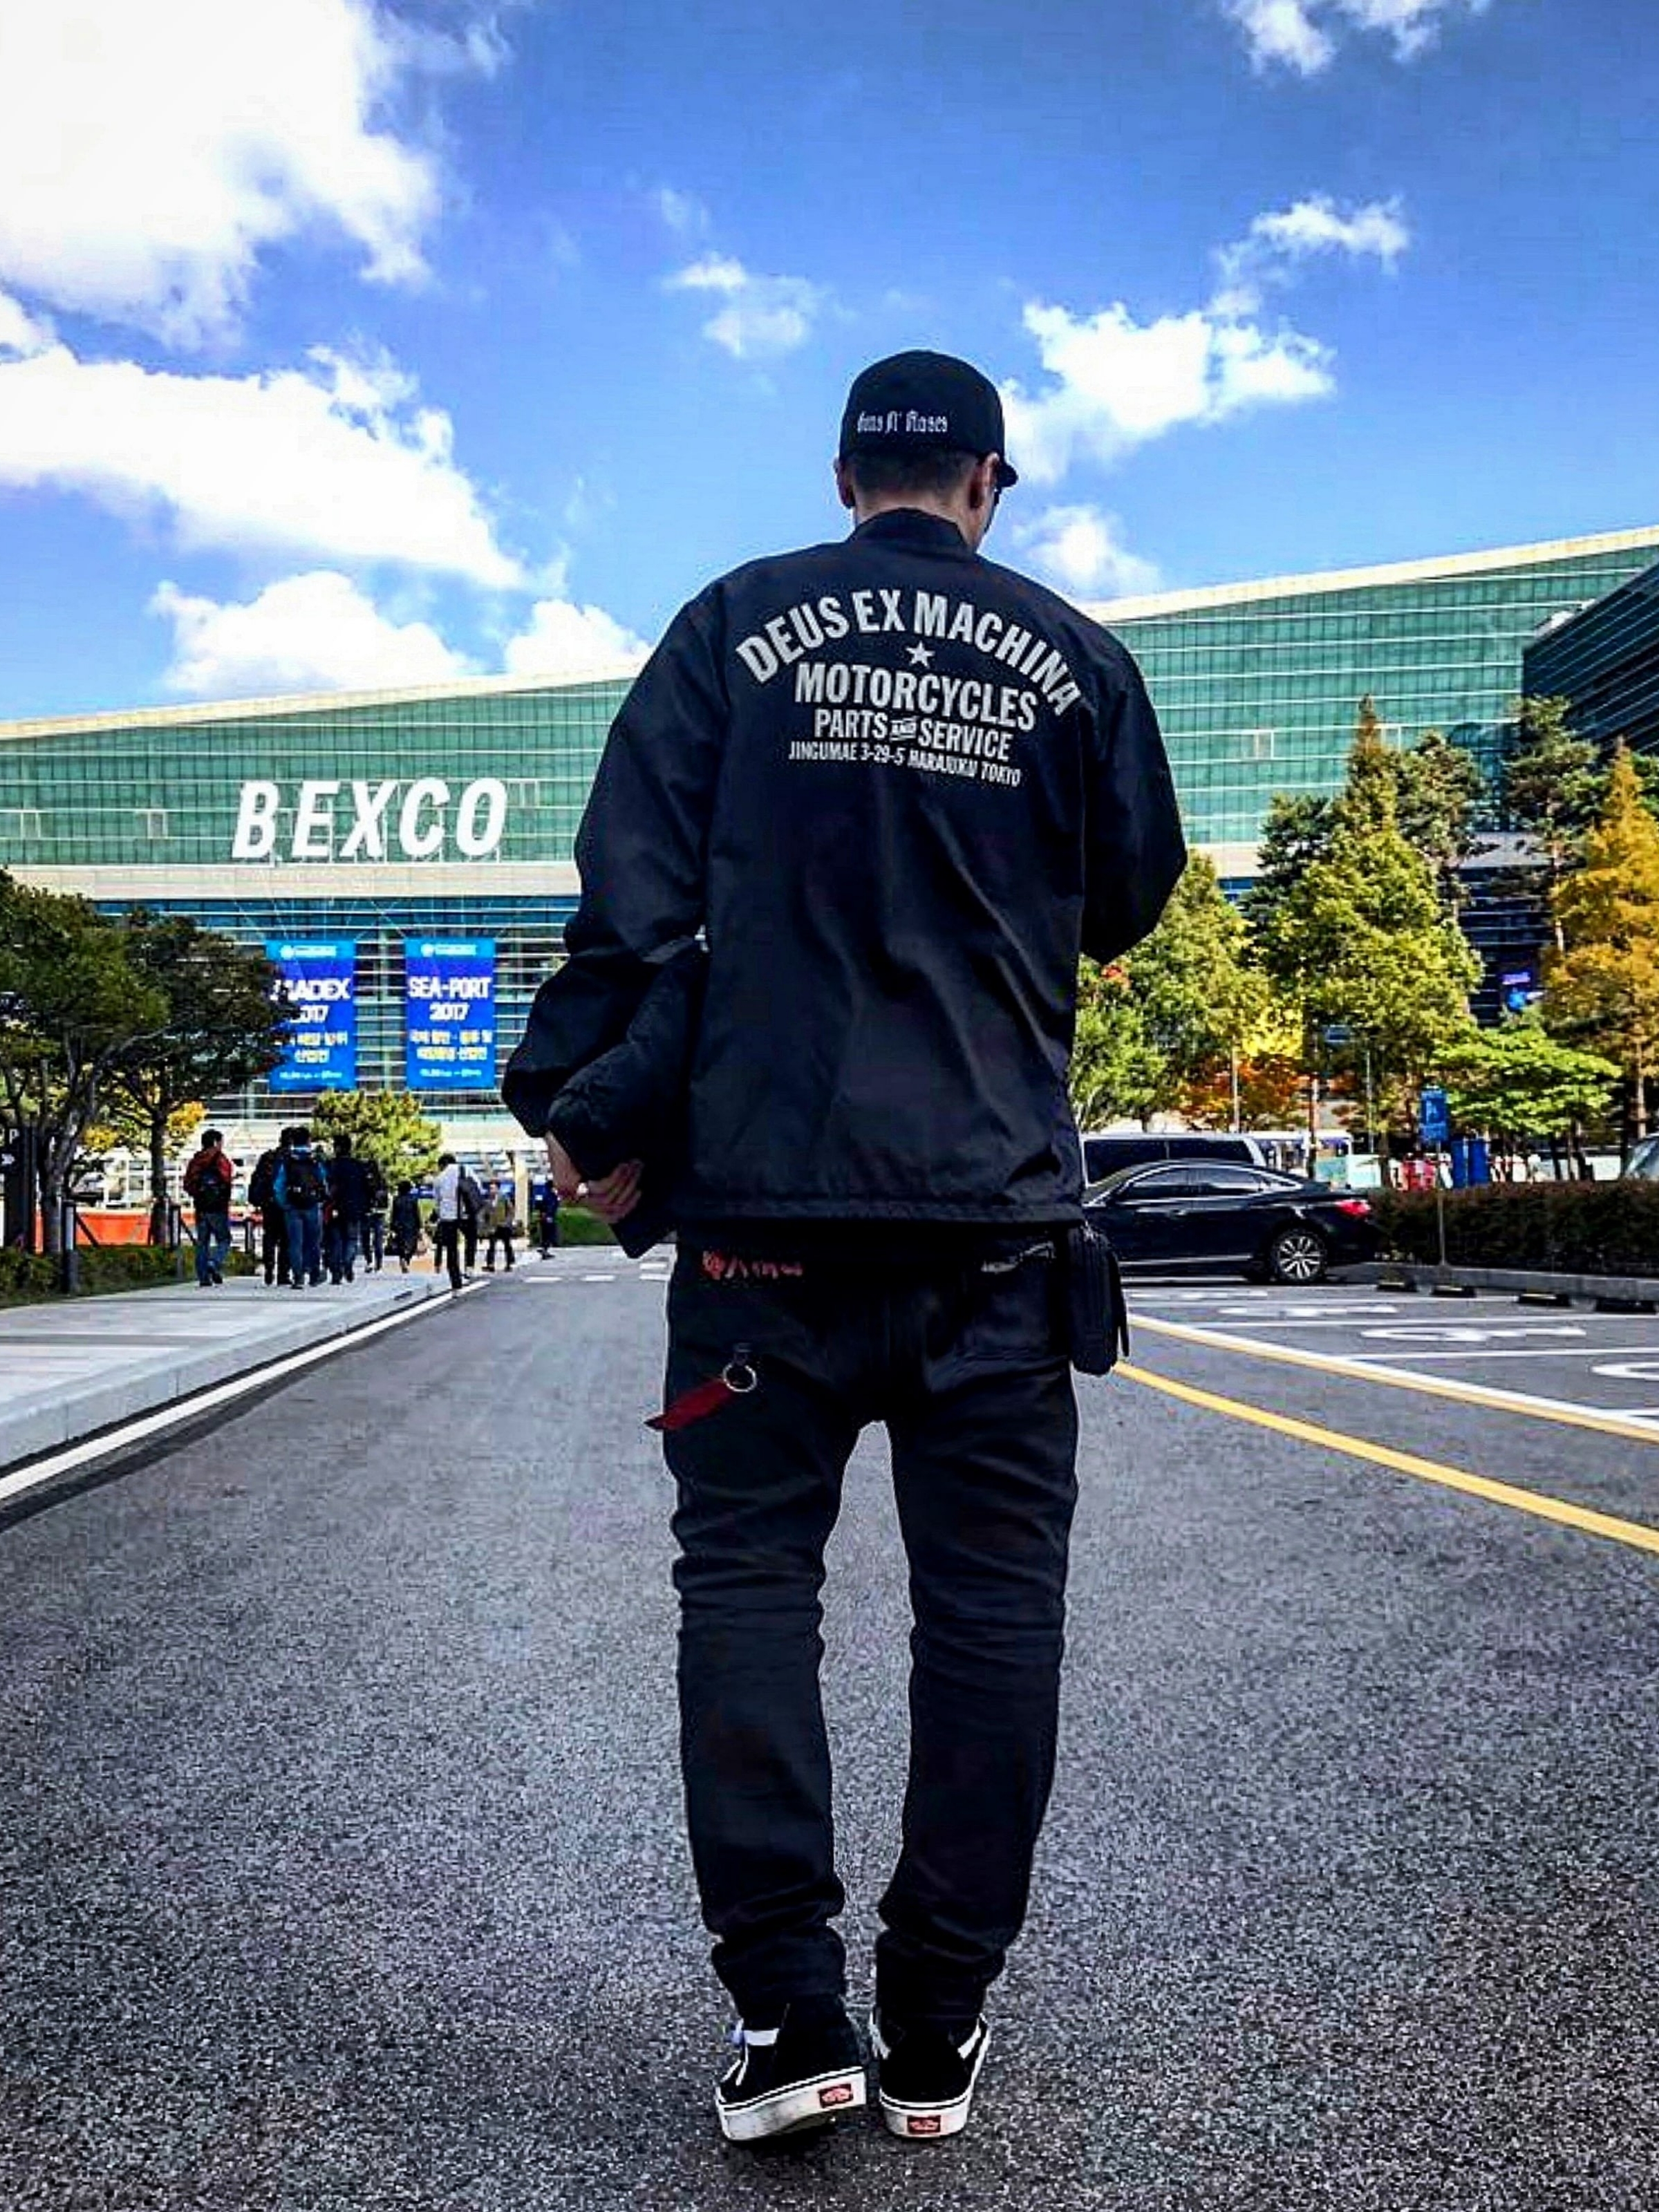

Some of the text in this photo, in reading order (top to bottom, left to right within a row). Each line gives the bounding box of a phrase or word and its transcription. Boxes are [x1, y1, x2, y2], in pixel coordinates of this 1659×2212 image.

[905, 409, 948, 432] Roses
[735, 590, 1081, 716] DEUS EX MACHINA
[795, 661, 1038, 731] MOTORCYCLES
[814, 708, 888, 740] PARTS
[917, 717, 1014, 762] SERVICE
[789, 741, 857, 761] JINGUMAE
[860, 742, 906, 766] 3-29-5
[231, 776, 508, 859] BEXCO
[408, 976, 492, 1000] SEA-PORT
[429, 1002, 469, 1020] 2017
[9, 1128, 19, 1144] P
